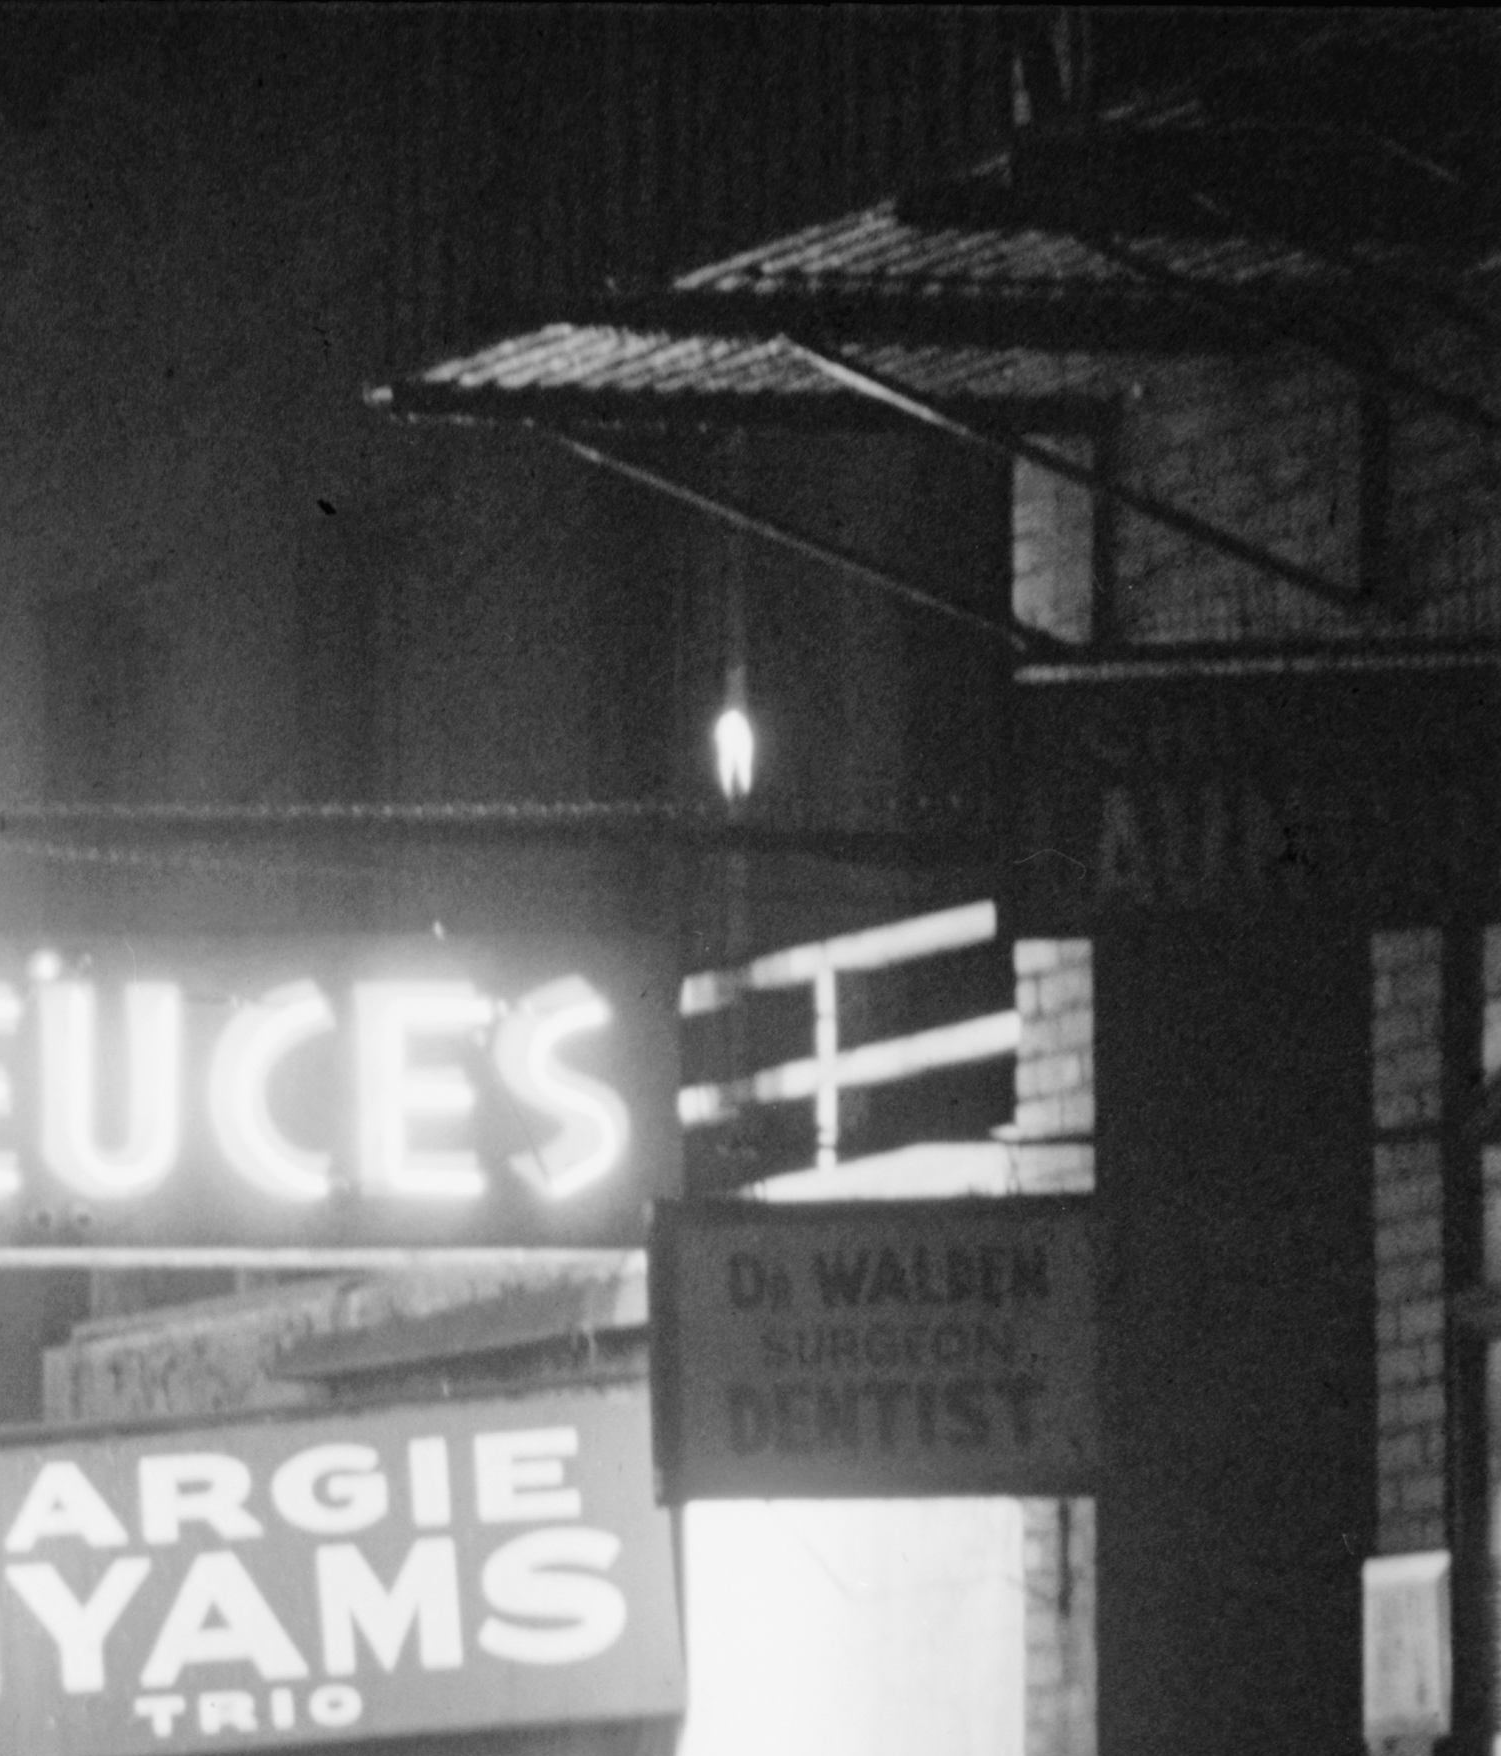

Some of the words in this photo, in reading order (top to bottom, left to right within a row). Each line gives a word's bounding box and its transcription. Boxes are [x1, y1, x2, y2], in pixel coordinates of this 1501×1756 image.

[760, 1320, 1017, 1368] SURGEON
[727, 1374, 1047, 1455] DENTIST
[133, 1684, 365, 1739] TRIO
